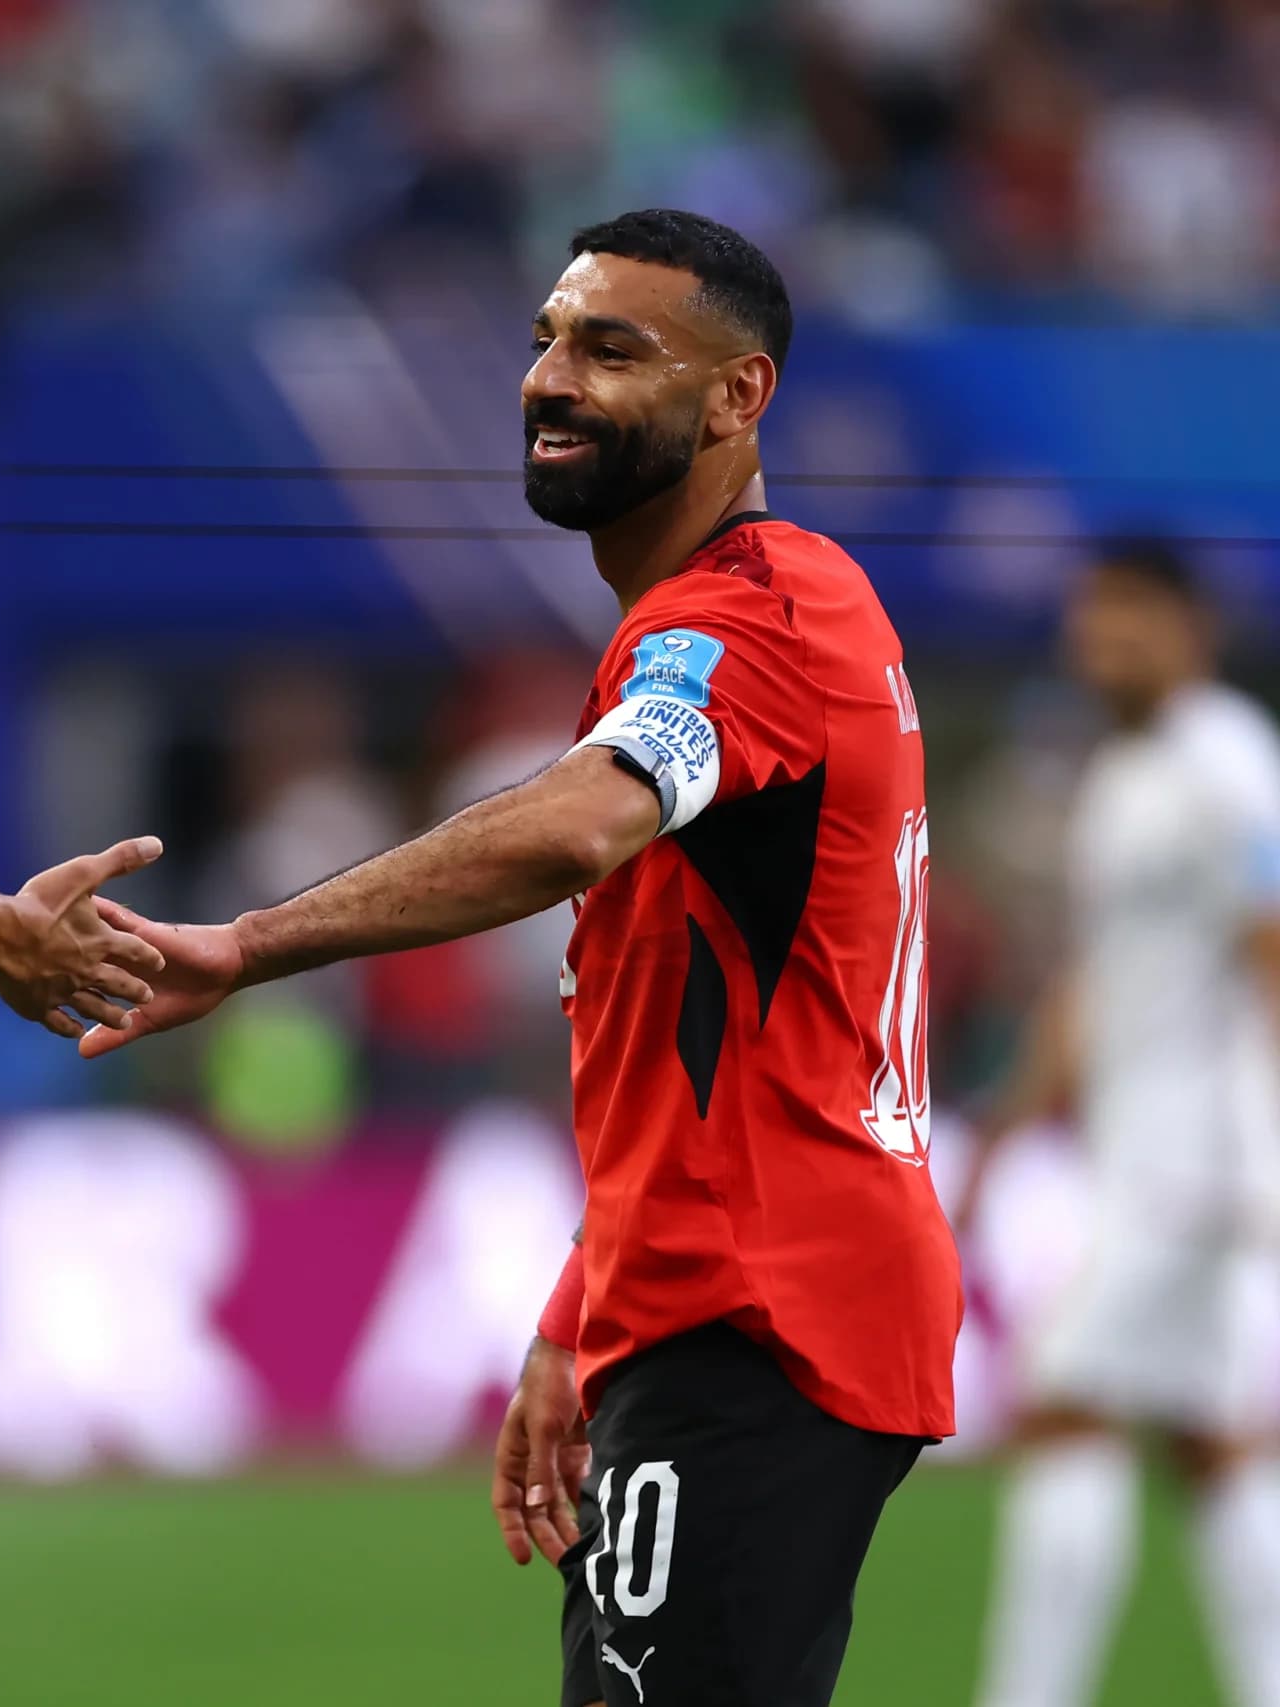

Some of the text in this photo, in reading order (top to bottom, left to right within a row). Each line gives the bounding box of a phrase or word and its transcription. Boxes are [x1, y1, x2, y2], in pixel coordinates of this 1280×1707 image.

[646, 665, 685, 685] PEACE
[652, 683, 674, 693] FIFA
[635, 706, 709, 768] UNITES
[644, 700, 715, 758] FOOTBALL
[656, 727, 699, 783] World
